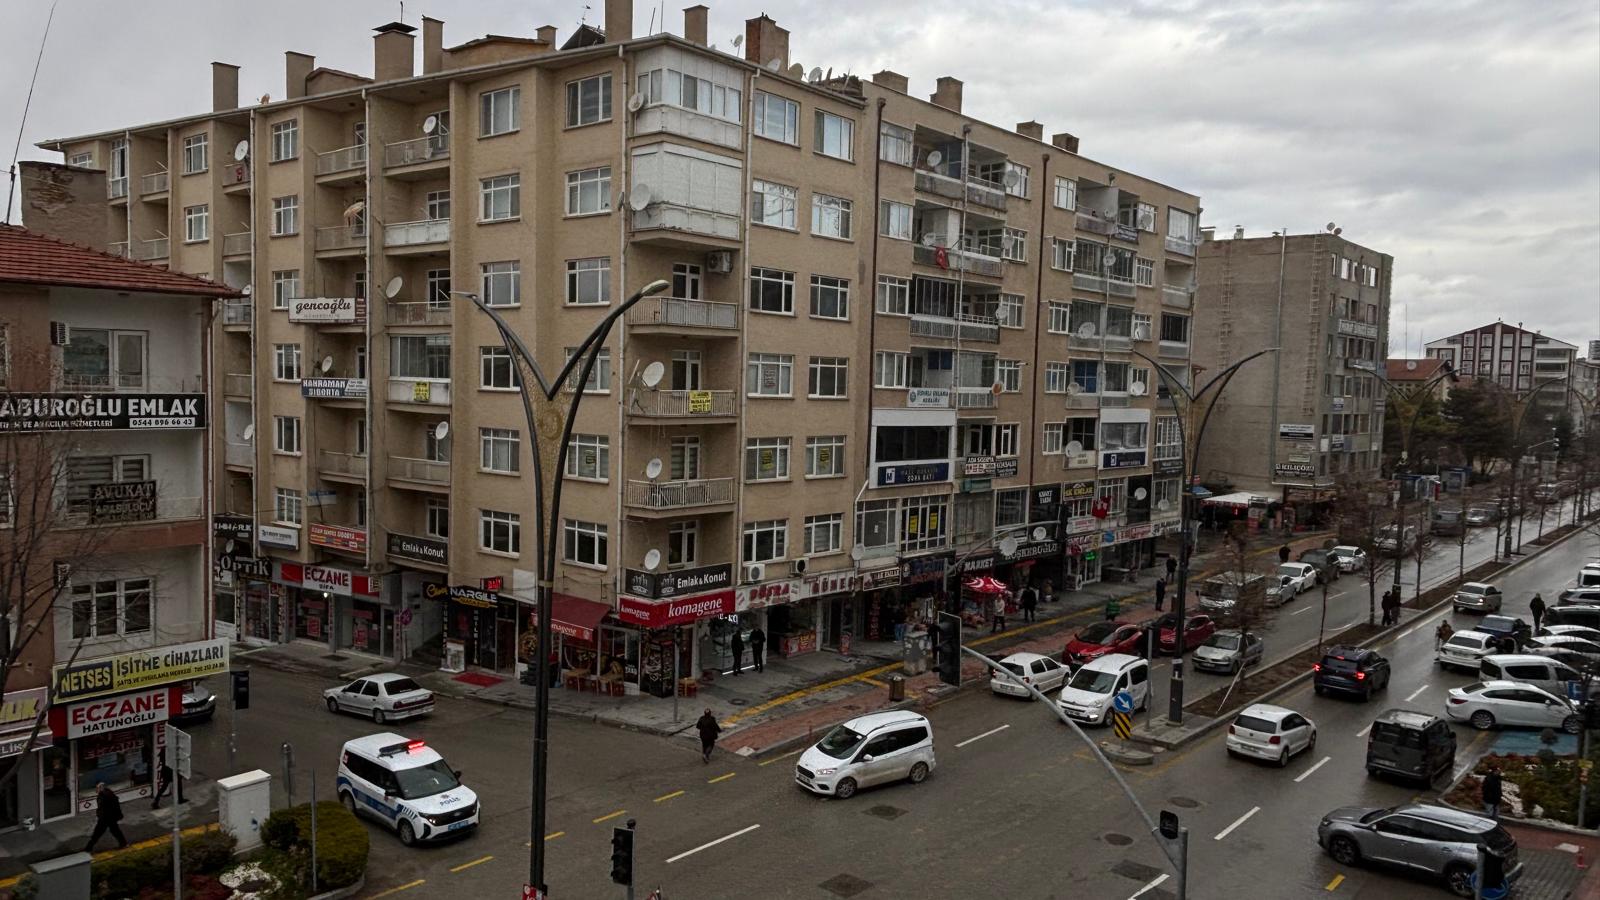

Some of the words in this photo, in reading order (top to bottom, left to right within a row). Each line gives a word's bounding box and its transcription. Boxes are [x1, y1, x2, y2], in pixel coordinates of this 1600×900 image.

[128, 398, 199, 416] EMLAK
[424, 545, 444, 559] Konut
[964, 557, 994, 572] MARKET
[304, 566, 349, 587] ECZANE
[677, 576, 699, 589] Emlak
[704, 571, 727, 585] Konut
[668, 597, 722, 618] komagene
[116, 657, 161, 678] İŞİTME
[163, 644, 224, 669] CİHAZLARI
[60, 666, 112, 694] NETSES
[72, 692, 167, 726] ECZANE
[82, 712, 156, 735] HATUNOĞLU
